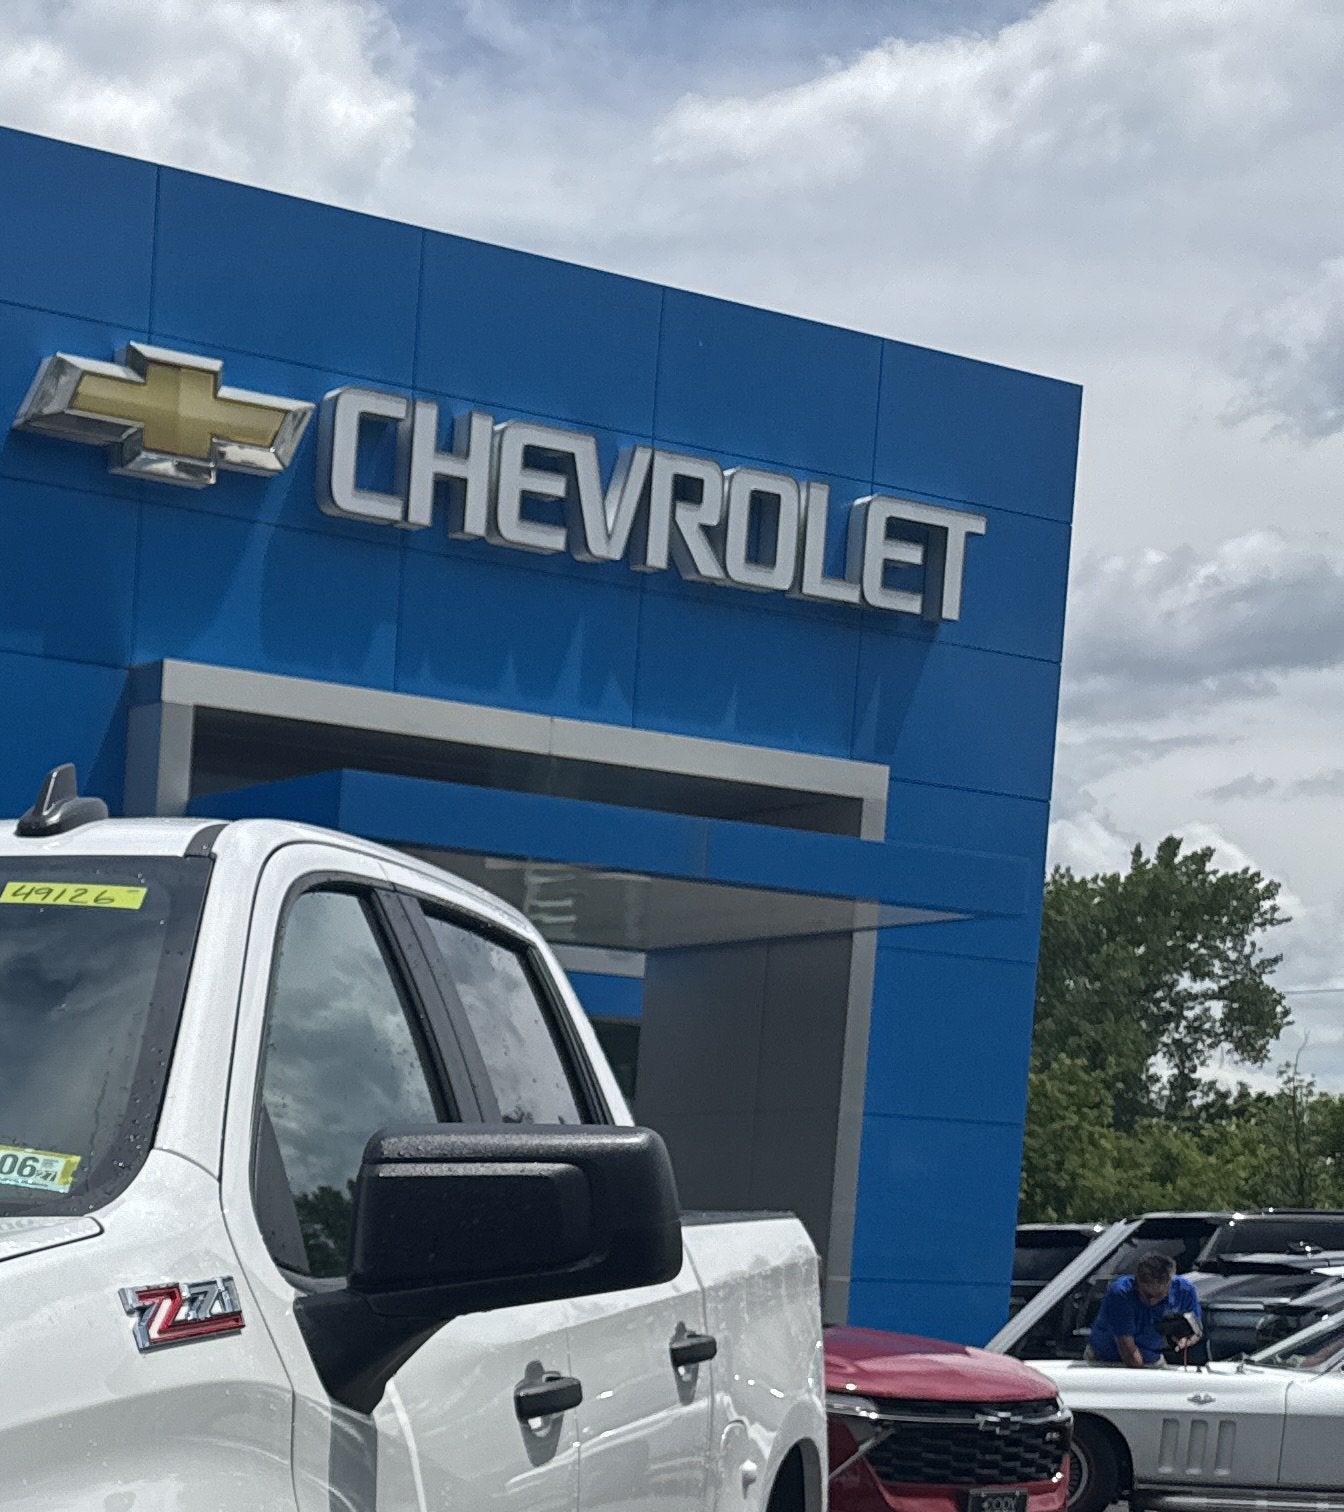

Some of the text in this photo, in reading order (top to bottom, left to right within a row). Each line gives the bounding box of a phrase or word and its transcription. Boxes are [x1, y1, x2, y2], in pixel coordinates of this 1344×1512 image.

[318, 386, 987, 623] CHEVROLET
[11, 884, 115, 905] 49126
[118, 1276, 245, 1350] Z71
